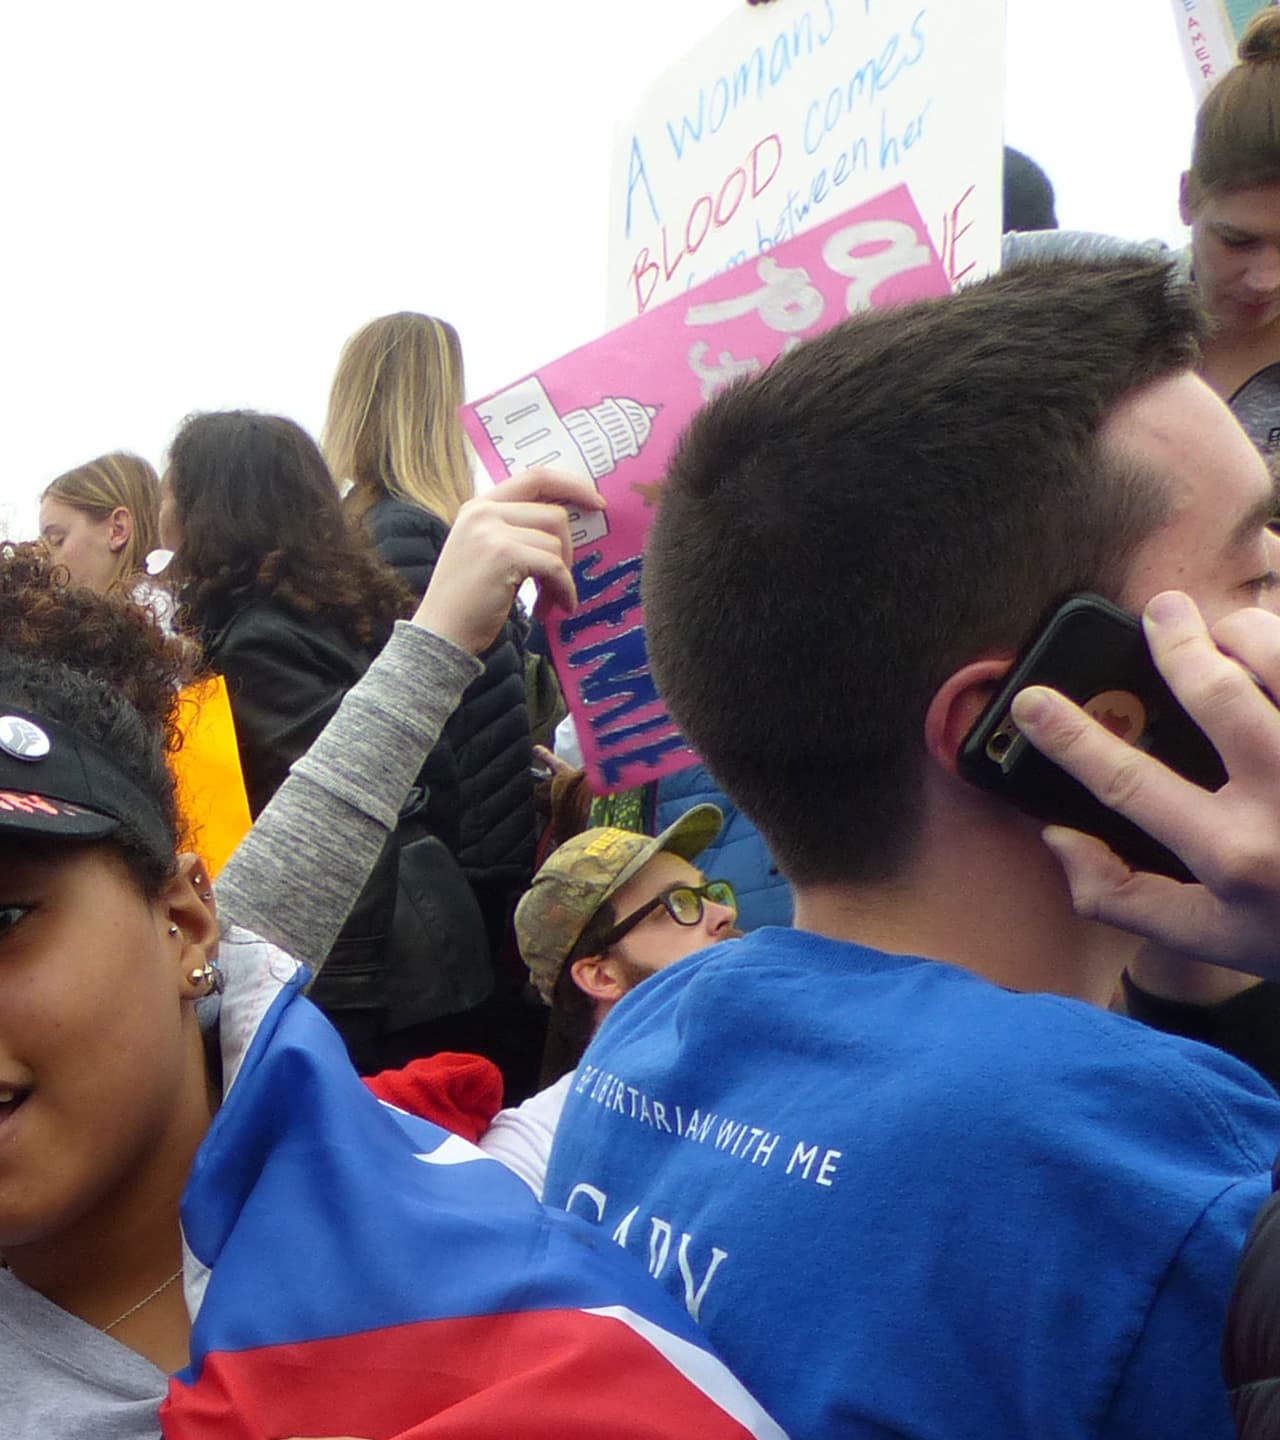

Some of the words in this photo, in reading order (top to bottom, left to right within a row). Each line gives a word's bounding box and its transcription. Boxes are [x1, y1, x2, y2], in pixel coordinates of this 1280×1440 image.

[1188, 17, 1215, 80] AMER
[626, 136, 660, 239] A
[628, 134, 783, 315] BLOOD
[803, 9, 927, 155] comes
[715, 1118, 781, 1167] WITH
[785, 1141, 842, 1187] ME
